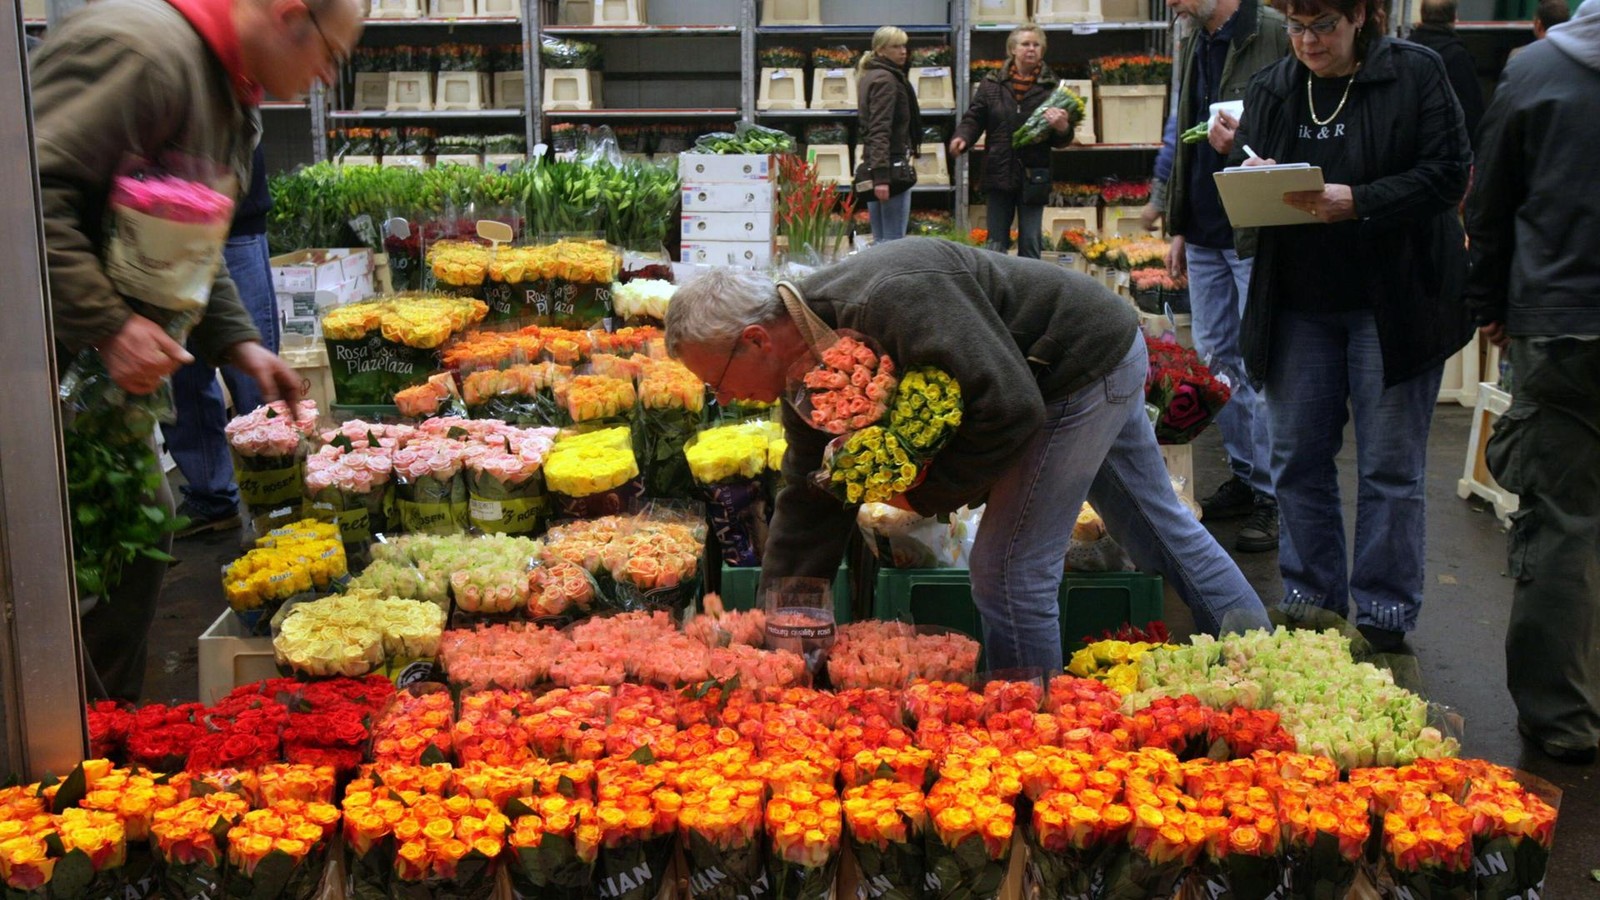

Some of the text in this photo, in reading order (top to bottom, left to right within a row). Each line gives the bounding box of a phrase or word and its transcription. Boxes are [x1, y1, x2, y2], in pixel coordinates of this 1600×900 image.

[1317, 126, 1330, 140] &
[1334, 123, 1345, 137] R
[336, 344, 368, 360] Rosa
[418, 512, 445, 526] OSEN
